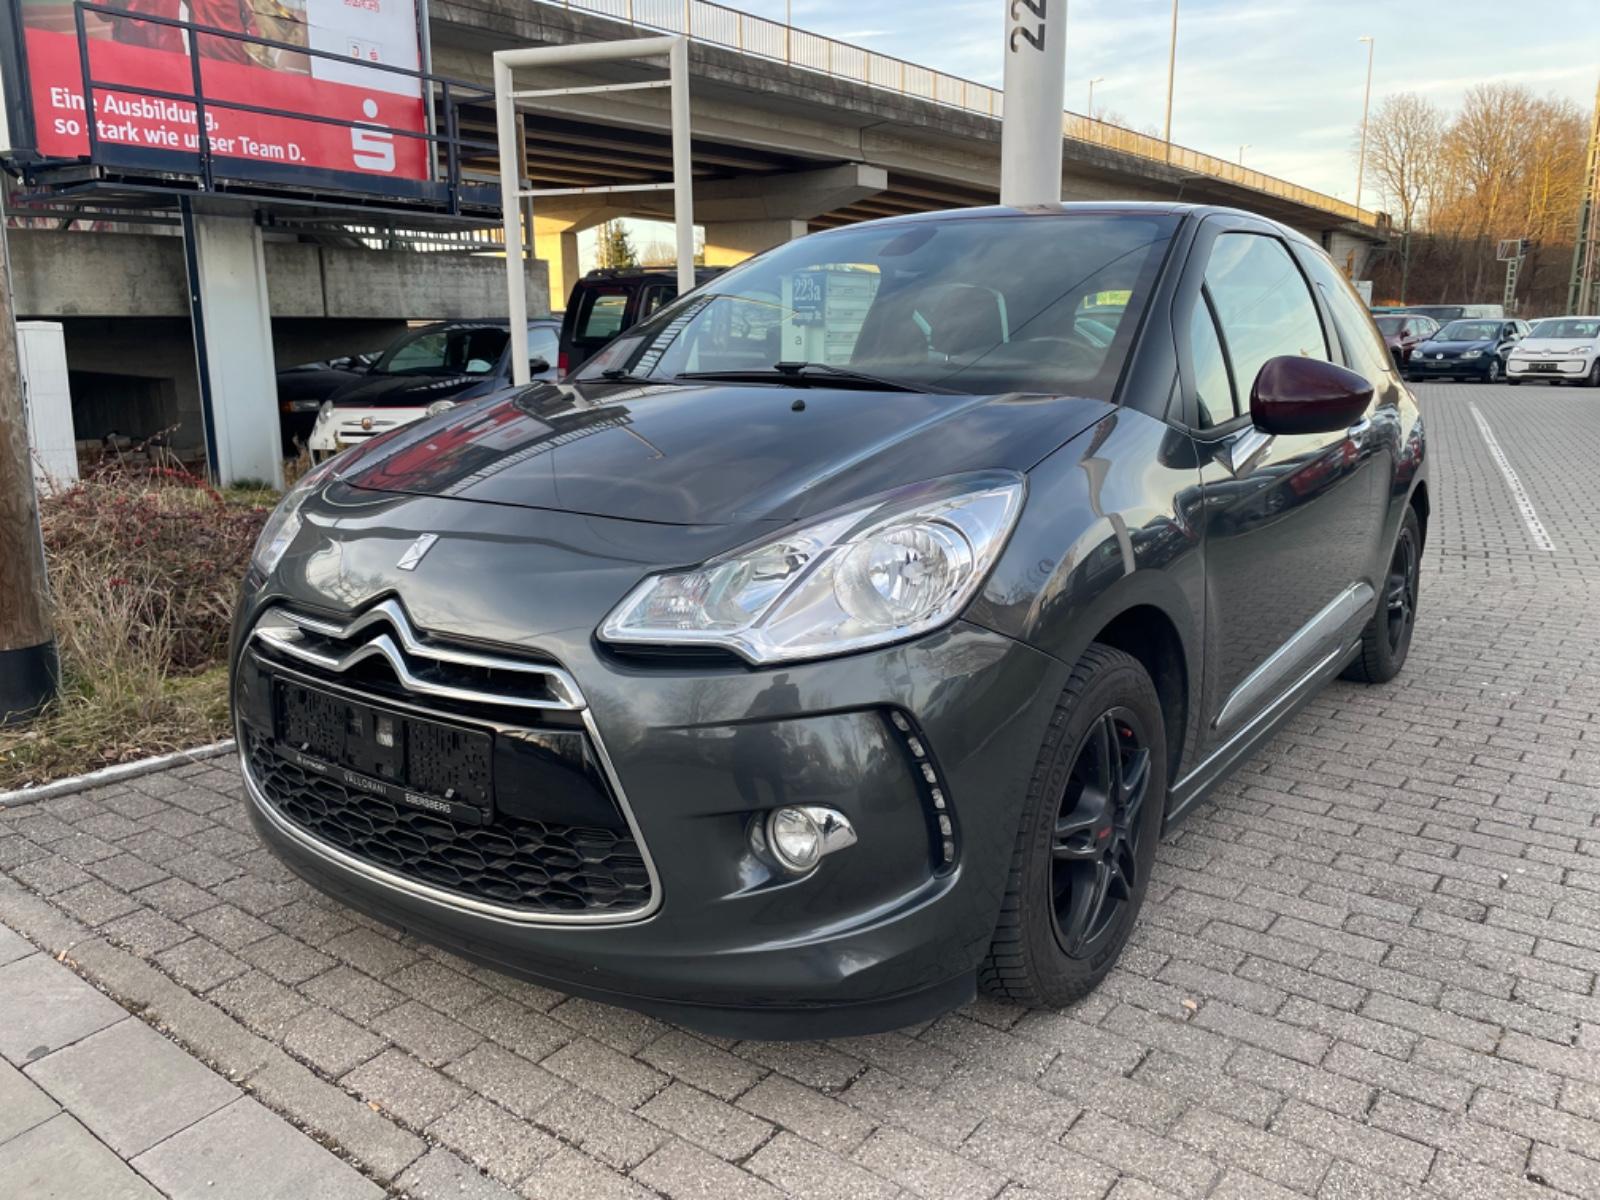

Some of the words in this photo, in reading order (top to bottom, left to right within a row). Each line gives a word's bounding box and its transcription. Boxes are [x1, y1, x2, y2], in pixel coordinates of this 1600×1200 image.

[54, 118, 80, 136] so
[143, 125, 179, 146] wie
[238, 136, 285, 155] Team
[287, 143, 306, 162] D.
[794, 278, 821, 301] 223a
